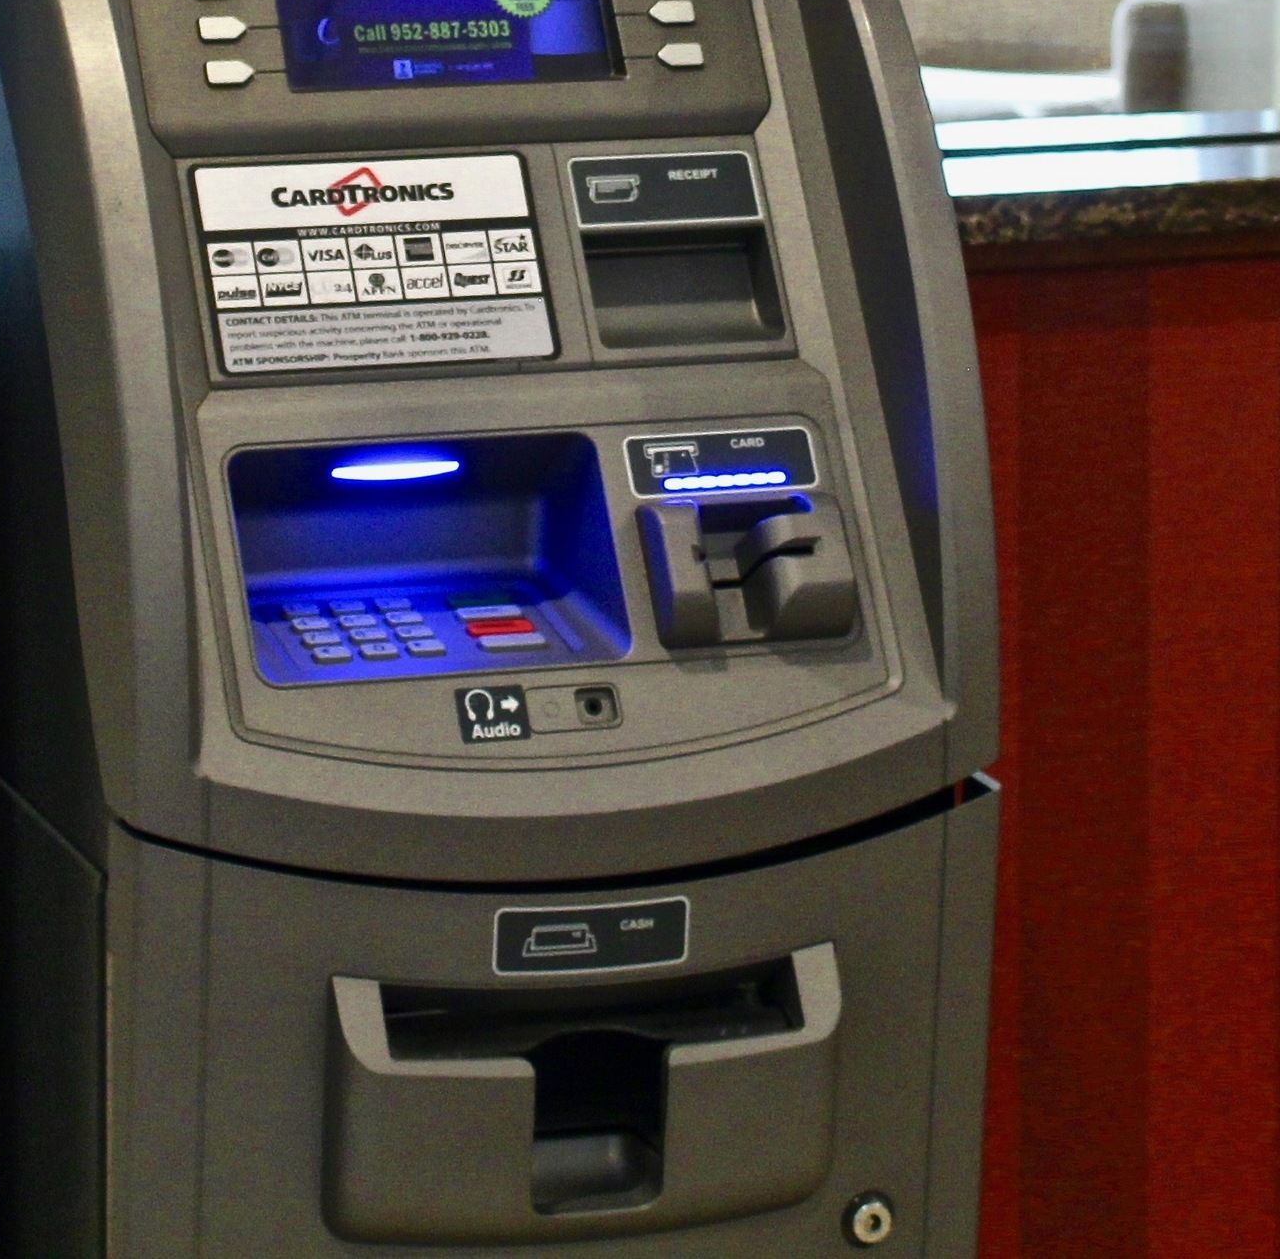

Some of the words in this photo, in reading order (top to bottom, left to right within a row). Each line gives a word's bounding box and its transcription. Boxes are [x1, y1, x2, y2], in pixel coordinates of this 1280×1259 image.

[353, 24, 386, 42] Call
[390, 20, 510, 41] 952-887-5303
[667, 168, 718, 181] RECEIPT
[297, 222, 441, 237] WWW.CARDTRONICS.COM
[494, 242, 528, 254] STAR
[308, 249, 345, 261] VISA
[407, 273, 443, 290] accel
[226, 316, 271, 327] CONTACT
[274, 314, 318, 325] DETAILS:
[321, 313, 339, 322] This
[341, 311, 360, 320] ATM
[232, 357, 253, 366] ATM
[730, 437, 765, 449] CARD
[472, 723, 521, 740] Audio
[620, 918, 654, 931] CASH
